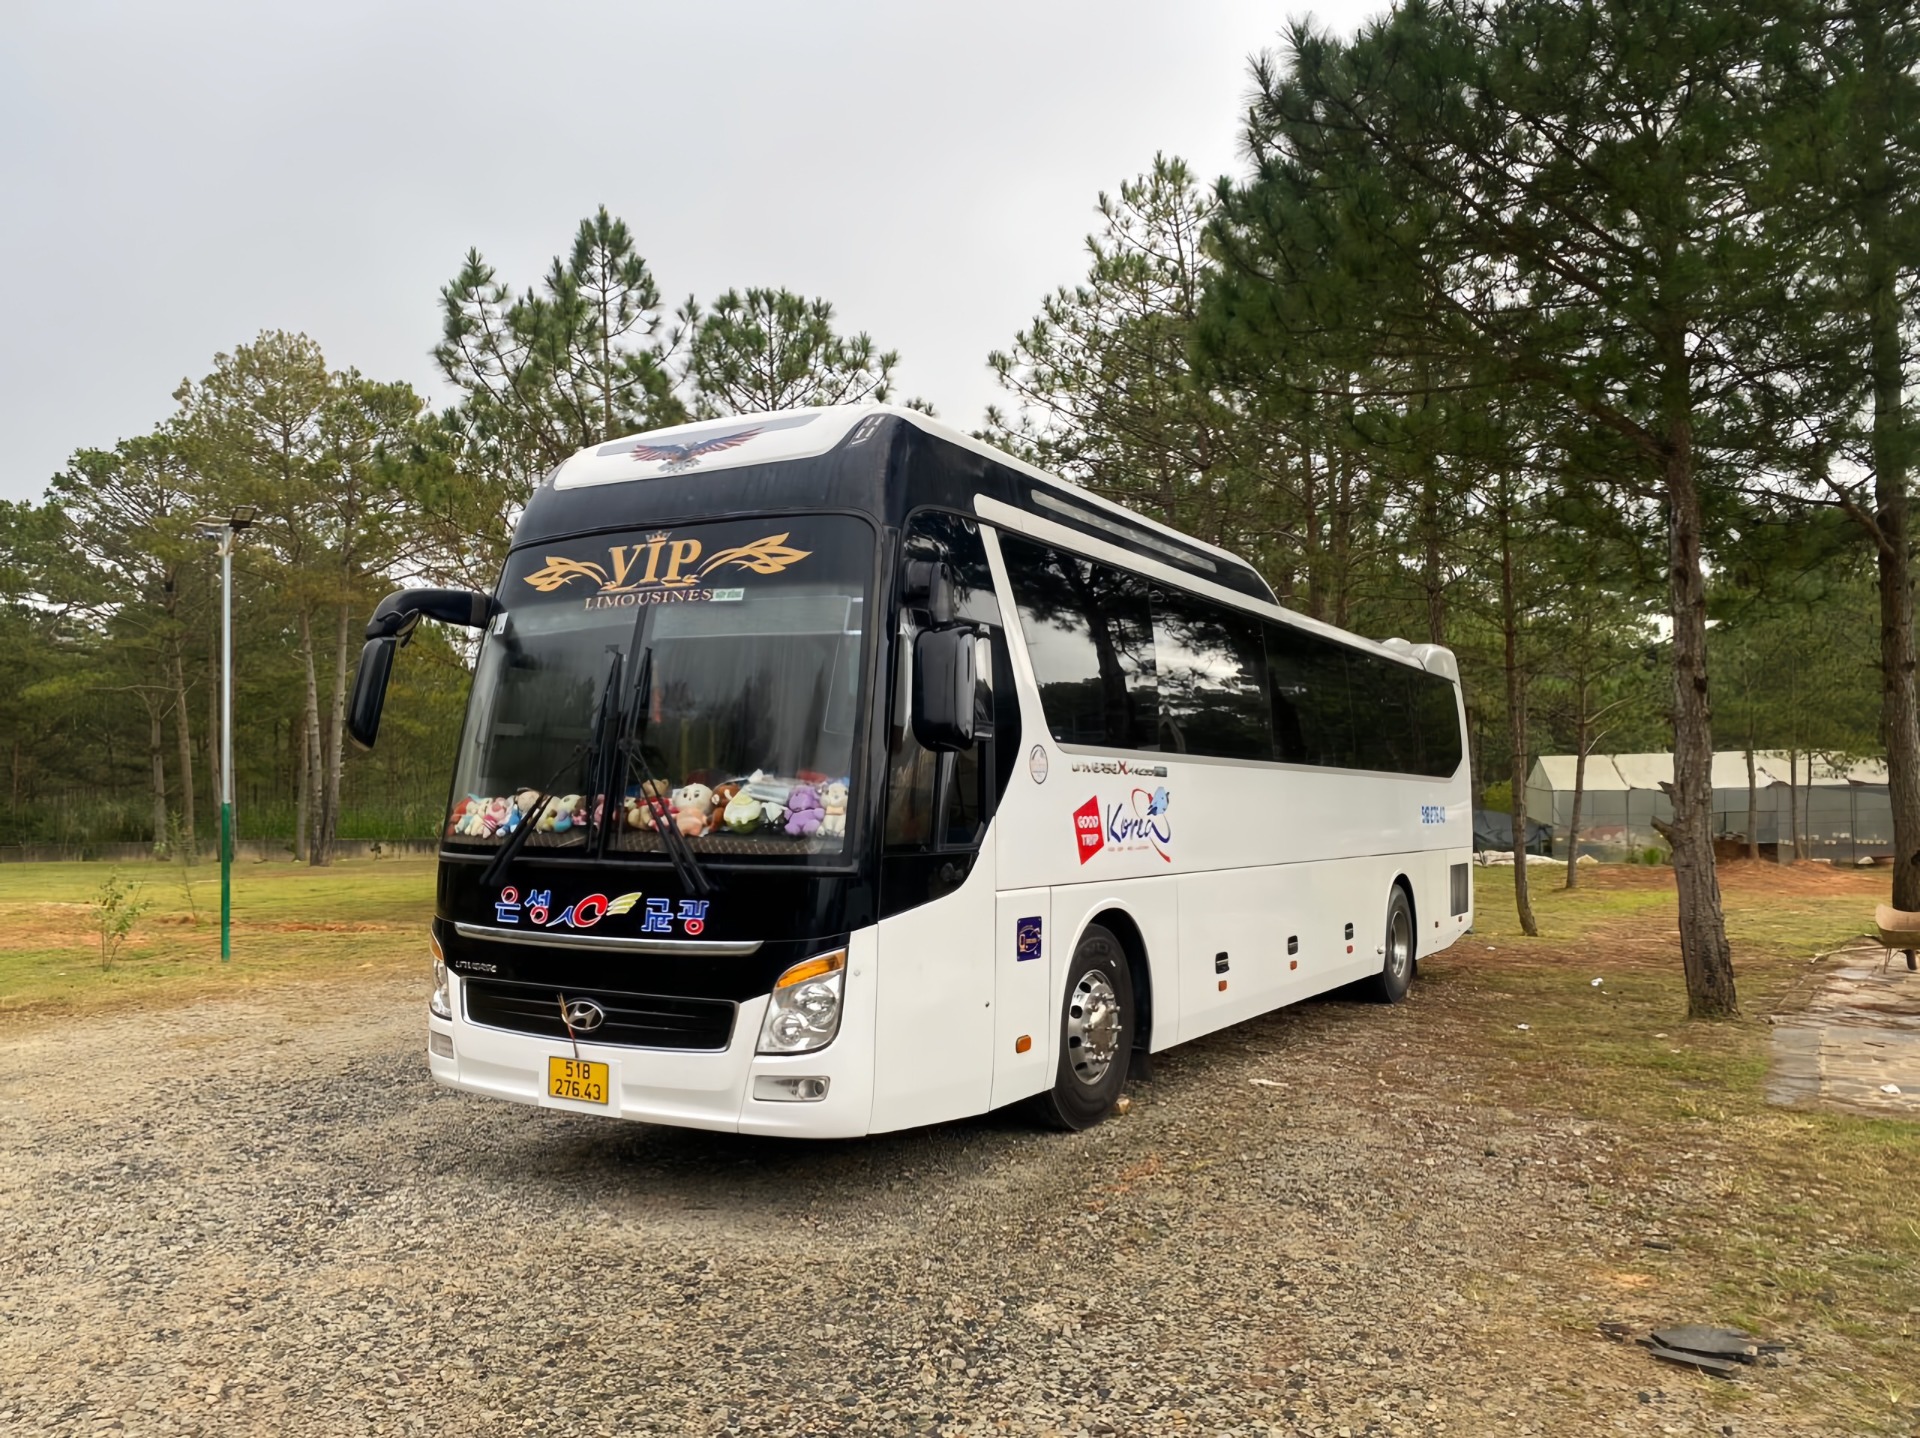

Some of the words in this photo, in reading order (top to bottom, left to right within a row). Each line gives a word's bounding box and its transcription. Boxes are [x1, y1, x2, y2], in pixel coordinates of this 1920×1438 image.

[608, 539, 702, 587] VIP
[584, 588, 713, 611] LIMOUSINES
[1077, 815, 1099, 829] GOOD
[495, 886, 551, 925] 은성
[565, 1060, 591, 1080] 51B
[555, 1078, 601, 1101] 276.43
